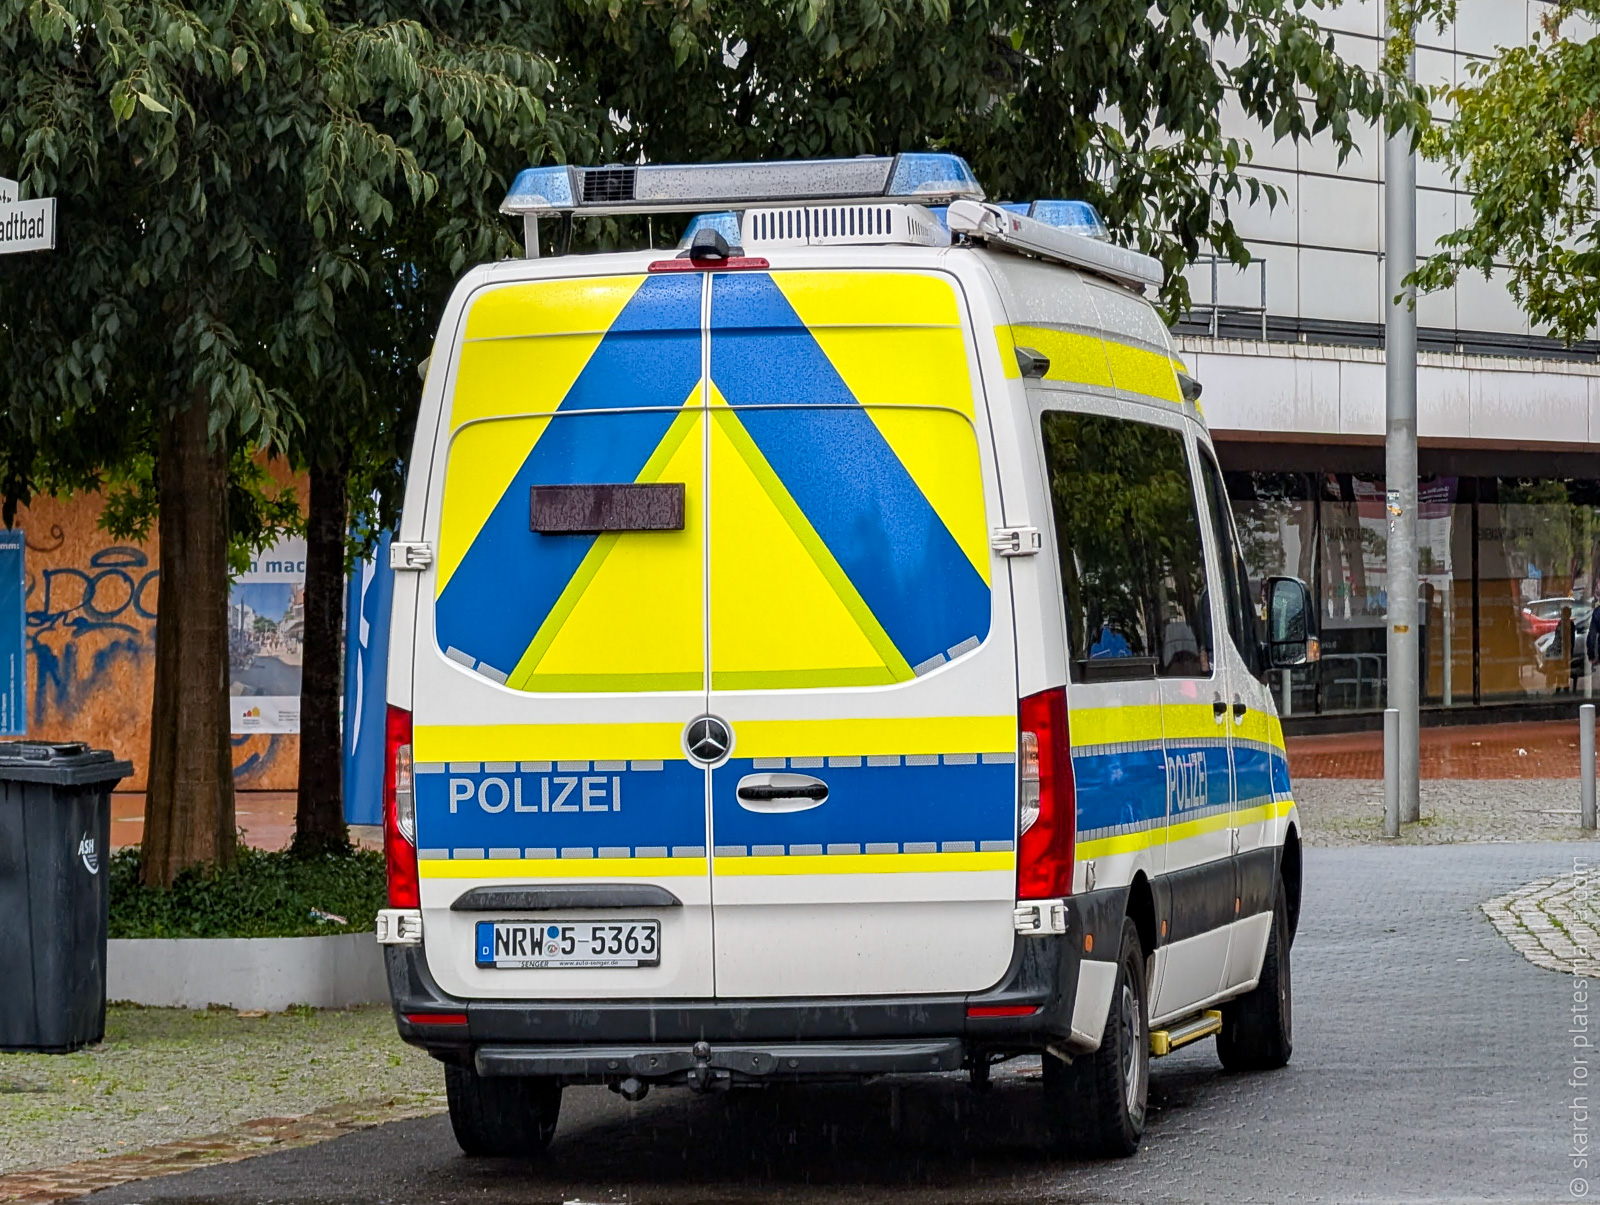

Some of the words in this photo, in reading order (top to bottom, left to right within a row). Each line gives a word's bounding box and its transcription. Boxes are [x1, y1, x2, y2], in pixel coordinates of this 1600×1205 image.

[449, 776, 621, 814] POLIZEI
[1167, 751, 1208, 813] POLIZEI
[78, 838, 95, 856] ASH
[482, 946, 490, 956] D
[495, 927, 545, 956] NRW
[561, 926, 656, 955] 5-5363
